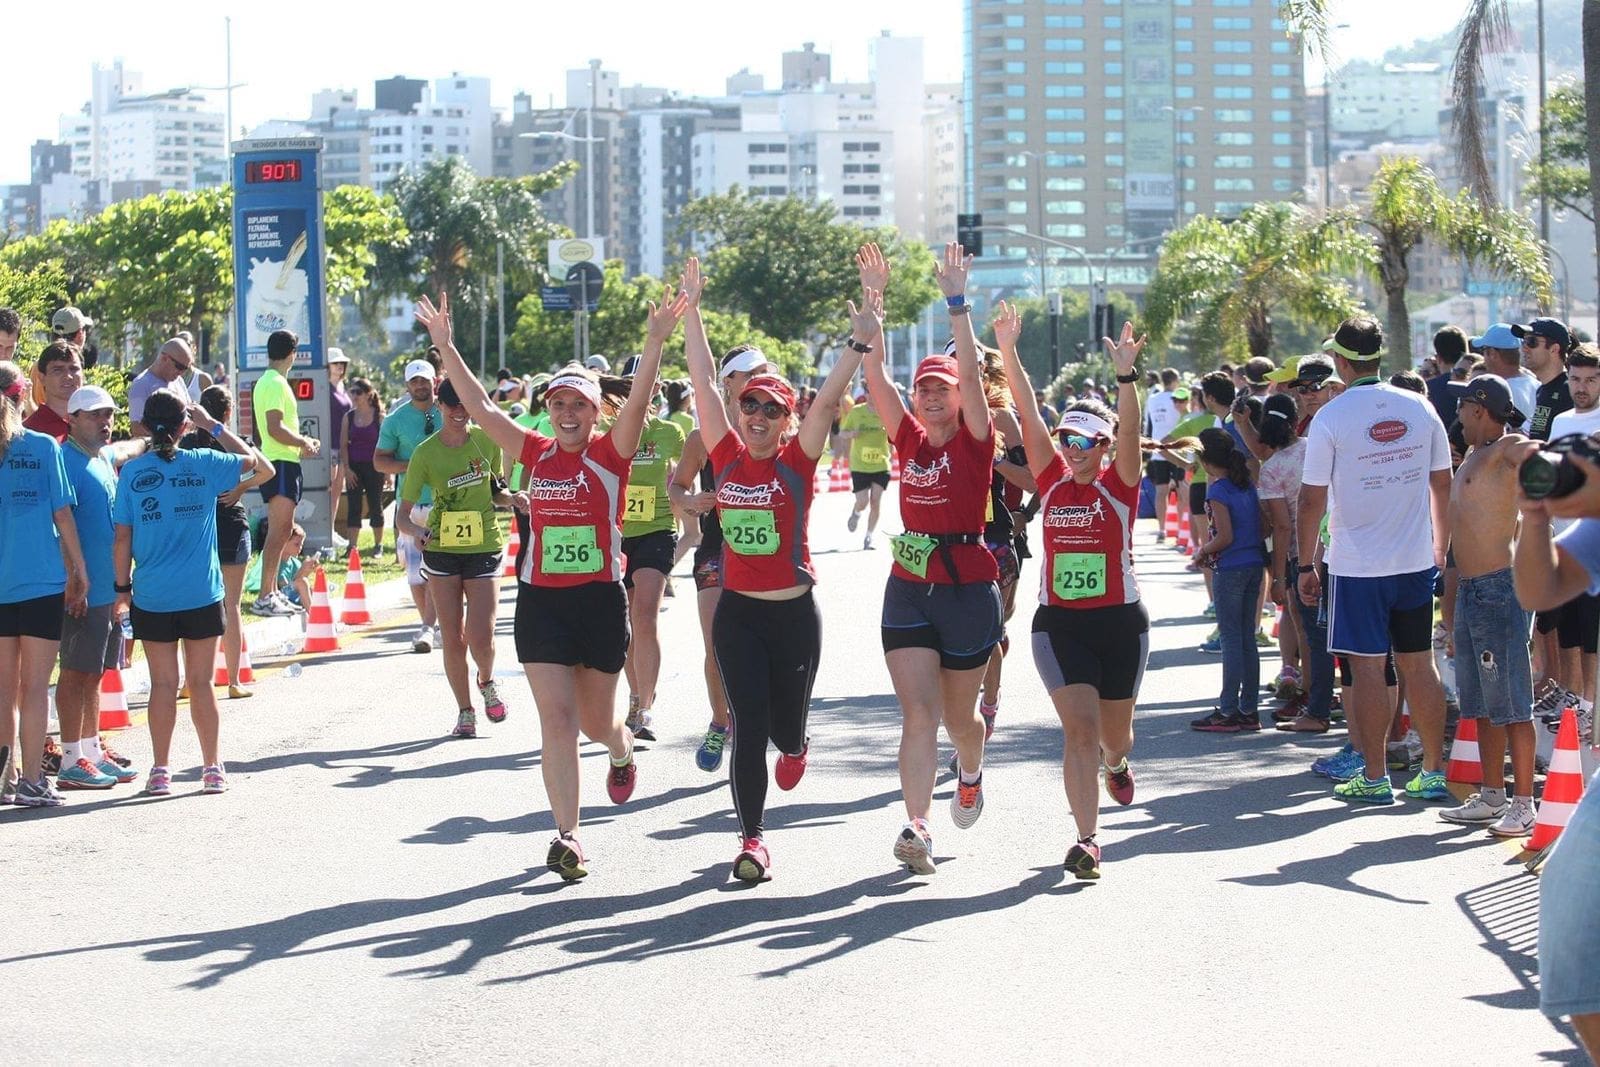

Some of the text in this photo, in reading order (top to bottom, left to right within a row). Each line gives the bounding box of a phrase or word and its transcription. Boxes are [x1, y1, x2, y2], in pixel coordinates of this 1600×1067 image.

[298, 381, 311, 398] 0
[8, 458, 41, 470] Takai
[168, 476, 206, 488] Takai
[448, 473, 475, 486] UNIMED
[723, 482, 766, 496] FLORIPA
[718, 491, 770, 504] RUNNERS
[627, 498, 645, 513] 21
[142, 511, 162, 522] RVB
[455, 524, 472, 538] 21
[732, 525, 769, 545] 256
[553, 544, 590, 563] 256
[898, 540, 924, 566] 256
[1063, 571, 1098, 590] 256
